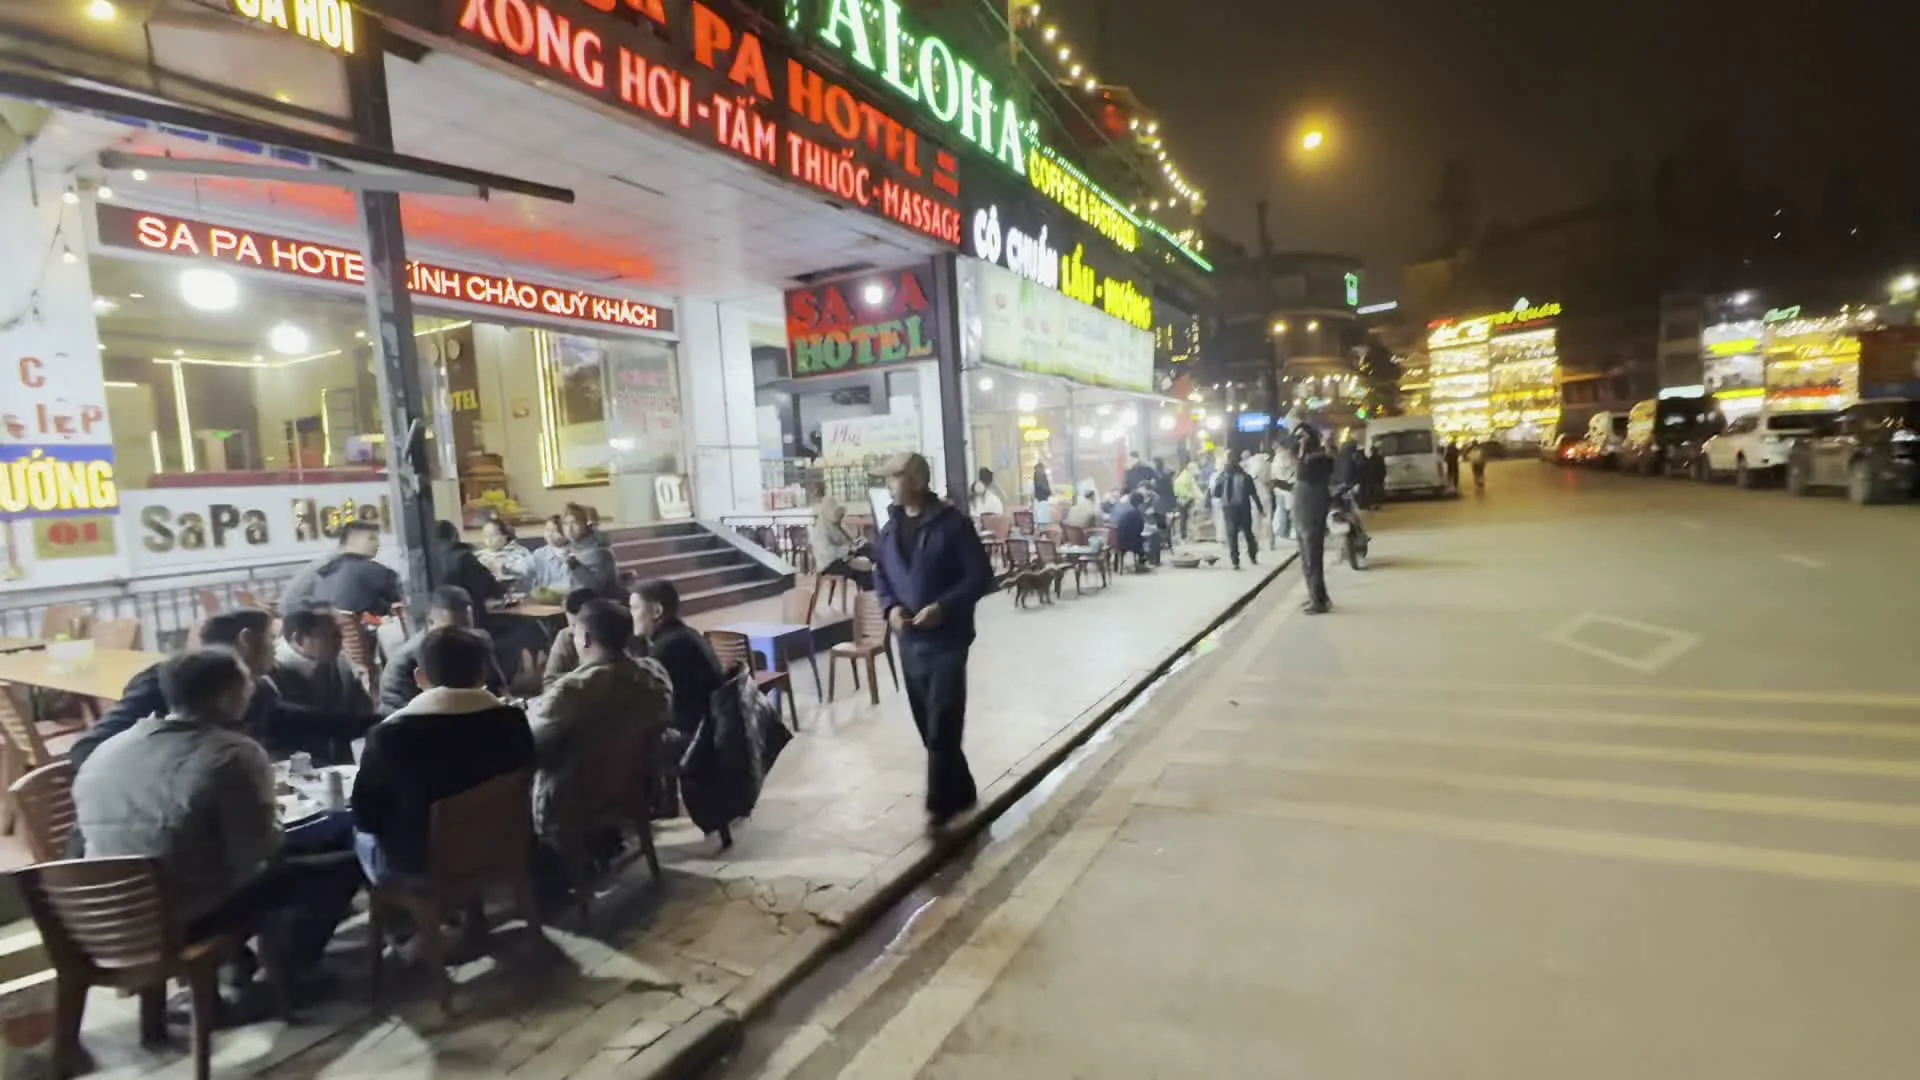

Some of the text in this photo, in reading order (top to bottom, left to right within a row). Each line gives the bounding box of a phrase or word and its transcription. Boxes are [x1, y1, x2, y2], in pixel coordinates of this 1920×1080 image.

[691, 0, 774, 101] PA
[820, 0, 1026, 176] ALOHA
[881, 176, 962, 246] MASSAGE
[1029, 146, 1080, 215] COFFEE
[137, 215, 658, 330] SA PA HOTE ÍNH CHÀO QUÝ KHÁCH
[790, 270, 929, 331] SA A
[793, 314, 935, 374] HOTEL
[140, 493, 395, 553] SaPa Hotel
